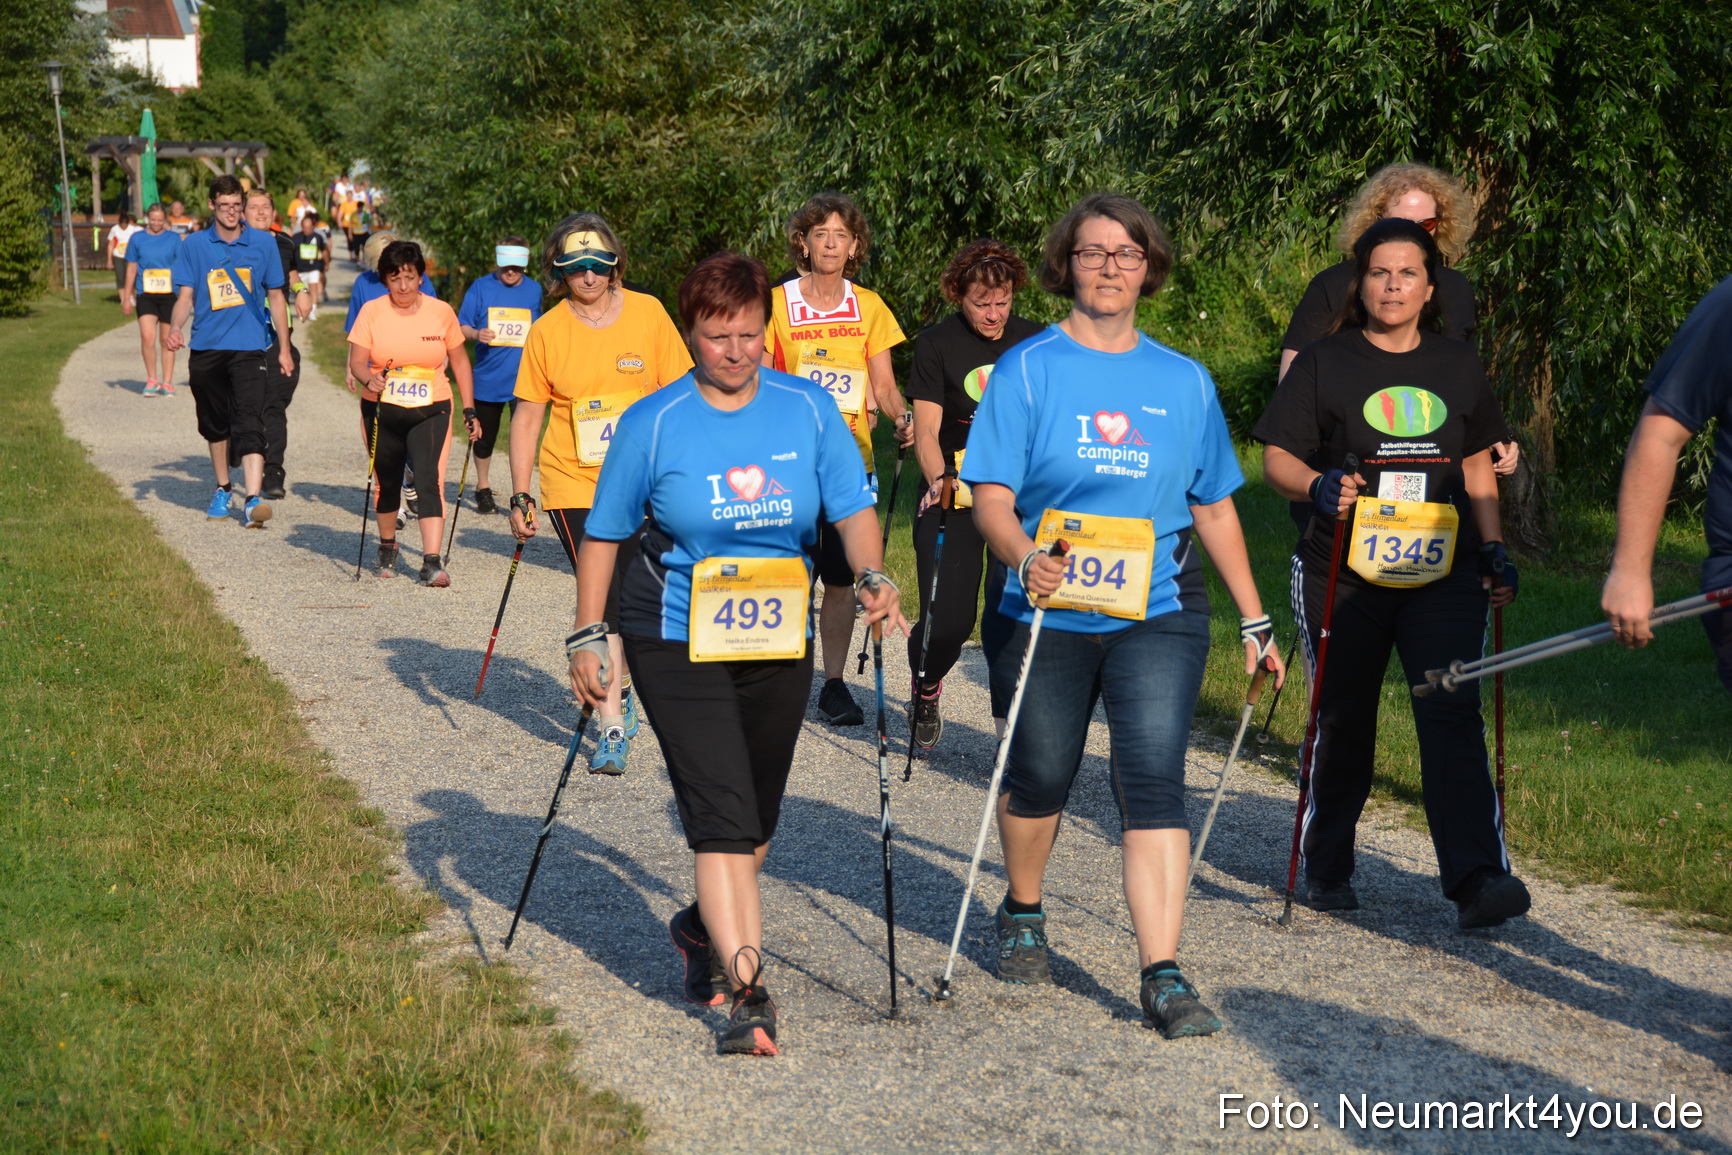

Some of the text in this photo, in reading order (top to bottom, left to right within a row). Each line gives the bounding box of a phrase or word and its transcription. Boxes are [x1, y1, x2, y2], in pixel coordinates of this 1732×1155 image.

[497, 323, 523, 336] 782
[790, 325, 866, 342] MAX BÖGL
[388, 381, 428, 398] 1446
[809, 370, 852, 394] 923
[1076, 415, 1092, 443] I
[1077, 445, 1149, 469] camping
[1376, 448, 1440, 456] Adipositas-Neumarkt
[1120, 466, 1148, 479] Berger
[706, 474, 726, 505] I
[712, 498, 793, 520] camping
[763, 517, 793, 527] Berger
[1371, 512, 1408, 523] firmenlauf
[1360, 521, 1389, 531] walken
[1054, 528, 1096, 540] firmenlauf
[1363, 534, 1445, 566] 1345
[711, 574, 753, 583] firmenlauf
[1063, 554, 1127, 590] 494
[699, 585, 732, 593] walken
[1059, 591, 1118, 603] Martina Queisser
[713, 597, 782, 630] 493
